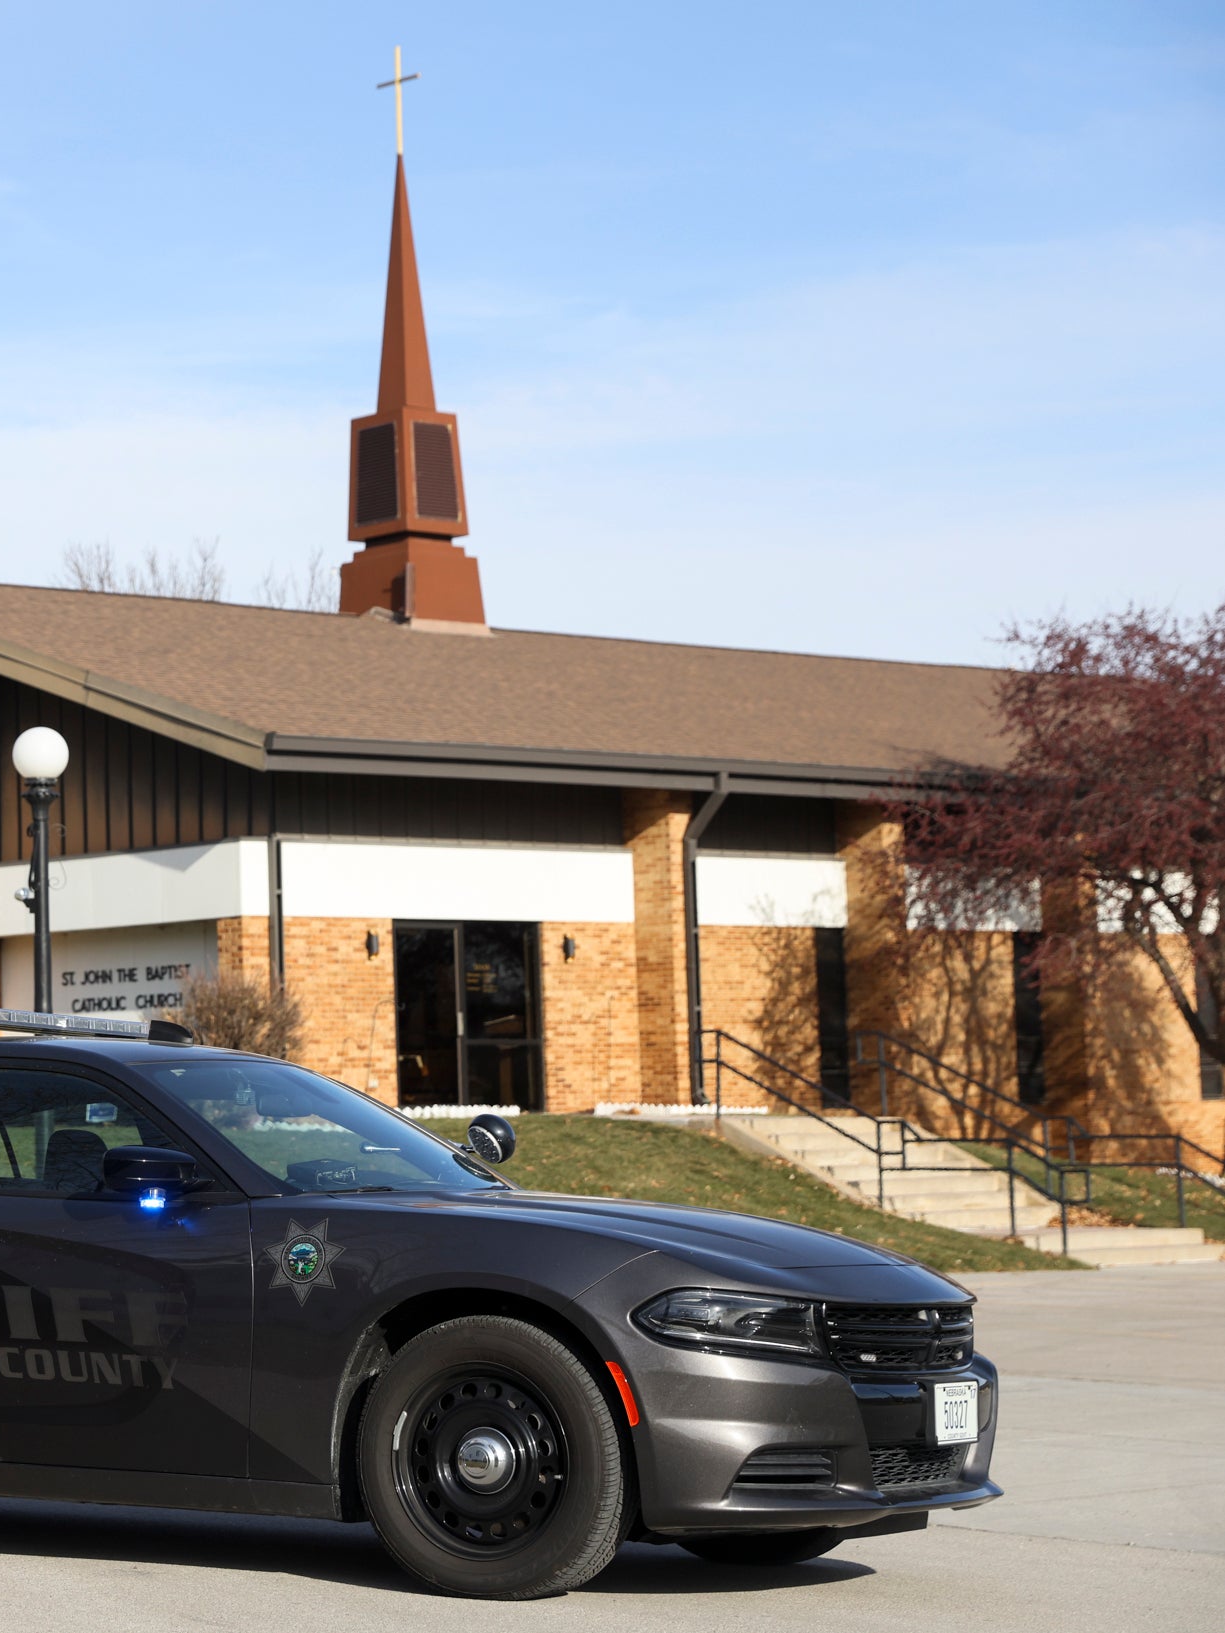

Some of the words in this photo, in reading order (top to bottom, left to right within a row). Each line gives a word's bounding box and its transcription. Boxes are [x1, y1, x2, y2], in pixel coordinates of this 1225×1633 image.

[80, 969, 112, 985] JOHN
[117, 967, 138, 983] THE
[145, 964, 191, 981] BAPTIST
[72, 996, 127, 1013] CATHOLIC
[135, 992, 183, 1009] CHURCH
[946, 1388, 966, 1397] NEBRASKA
[944, 1400, 968, 1429] 50327
